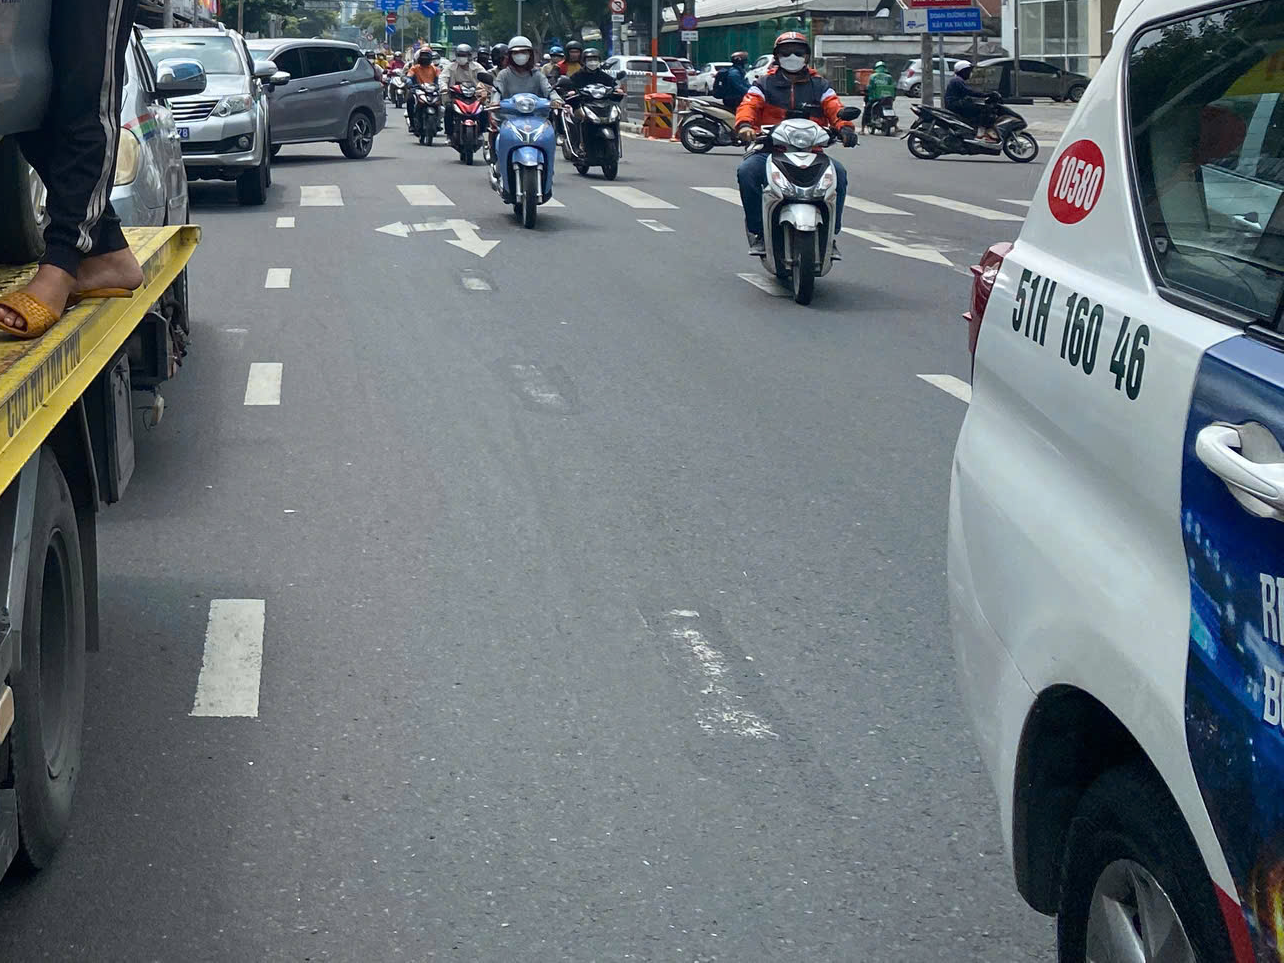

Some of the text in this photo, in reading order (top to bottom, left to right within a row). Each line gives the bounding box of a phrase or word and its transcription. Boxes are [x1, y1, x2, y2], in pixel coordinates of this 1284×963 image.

[1053, 155, 1103, 211] 10580
[1012, 268, 1150, 401] 51H 160 46
